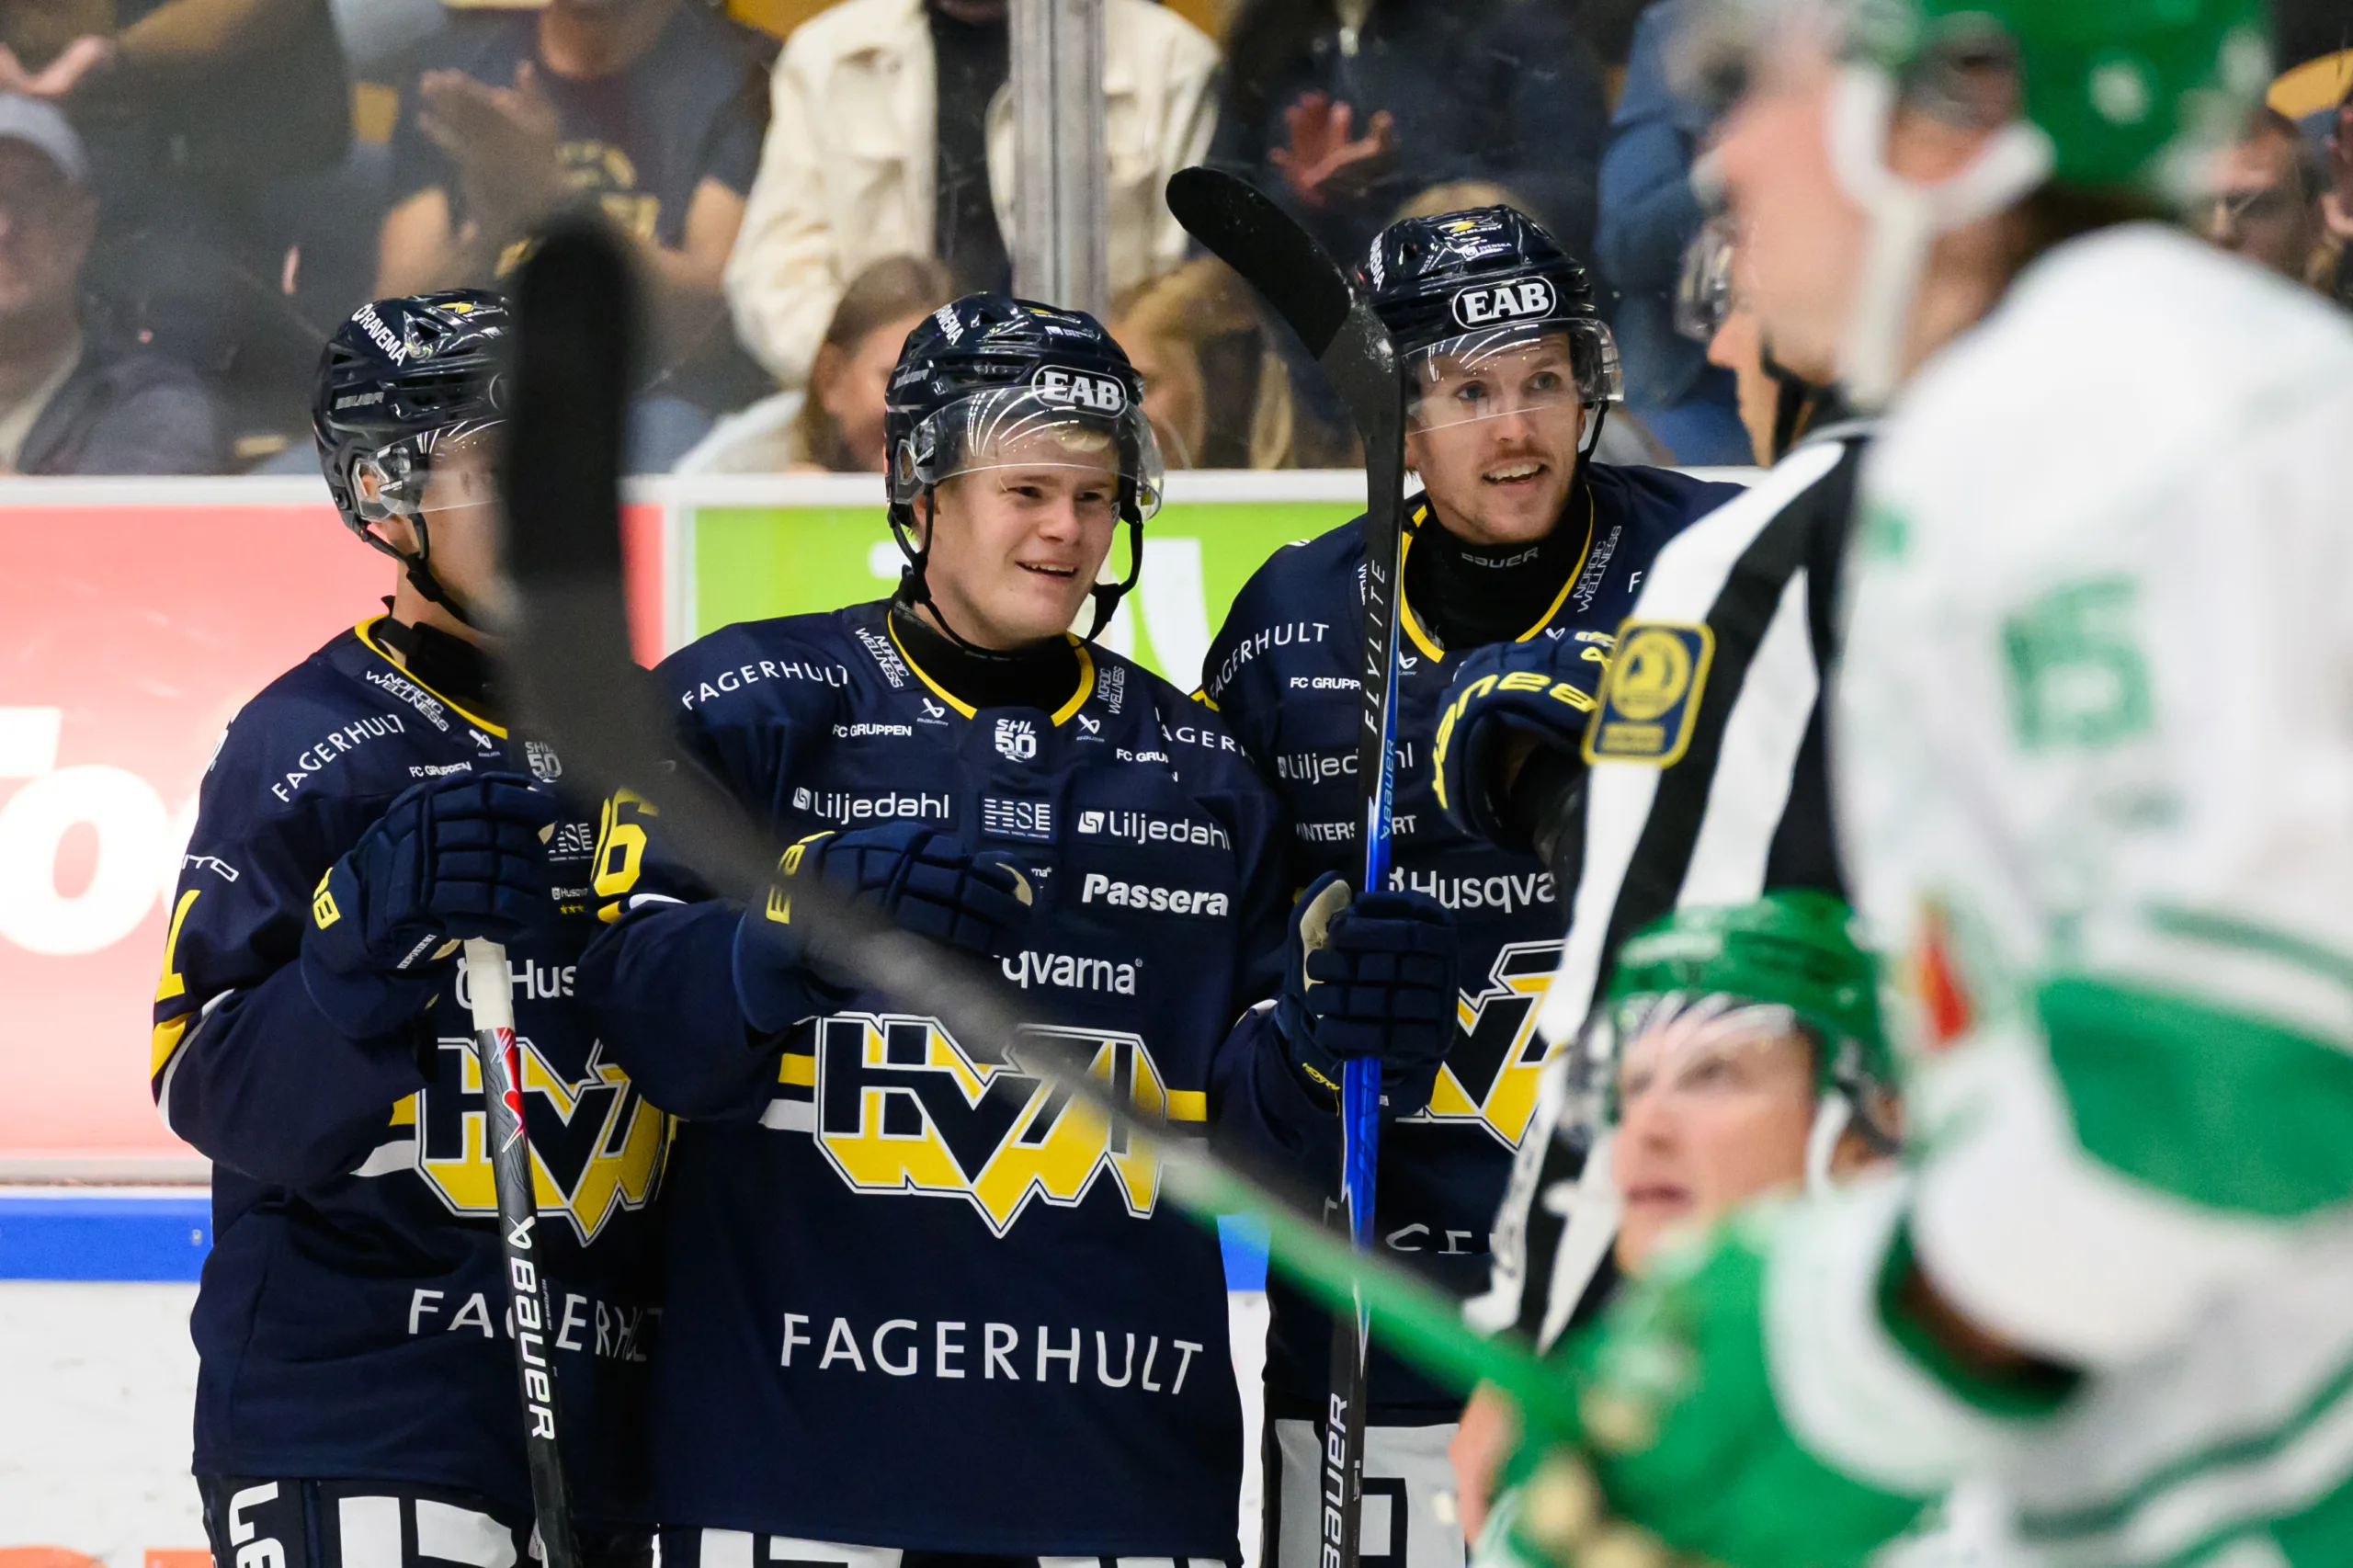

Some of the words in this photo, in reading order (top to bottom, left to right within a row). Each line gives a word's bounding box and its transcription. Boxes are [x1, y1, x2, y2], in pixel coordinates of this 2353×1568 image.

[1461, 282, 1550, 324] EAB
[1041, 370, 1121, 412] EAB
[1574, 540, 1607, 598] NORDIC
[1577, 526, 1622, 613] WELLNESS
[856, 628, 904, 688] WELLNESS
[874, 635, 910, 677] NORDIC
[1209, 621, 1330, 700] FAGERHULT
[1365, 559, 1385, 735] FLYLITE
[366, 670, 450, 733] WELLNESS
[384, 672, 445, 715] NORDIC
[682, 660, 848, 710] FAGERHULT
[1097, 668, 1111, 702] NORDIC
[1108, 665, 1126, 715] WELLNESS
[1290, 676, 1309, 688] FC
[1312, 676, 1361, 690] GRUPP
[833, 723, 848, 738] FC
[849, 722, 912, 737] GRUPPEN
[995, 719, 1036, 735] SHL
[995, 730, 1037, 760] 50
[271, 713, 405, 803] FAGERHULT
[409, 766, 425, 778] FC
[1116, 747, 1132, 762] FC
[815, 791, 949, 825] Liljedahl
[984, 798, 1051, 832] HSE
[1109, 811, 1231, 851] Liljedahl
[1082, 873, 1229, 916] Passera
[780, 1312, 1203, 1395] FAGERHULT
